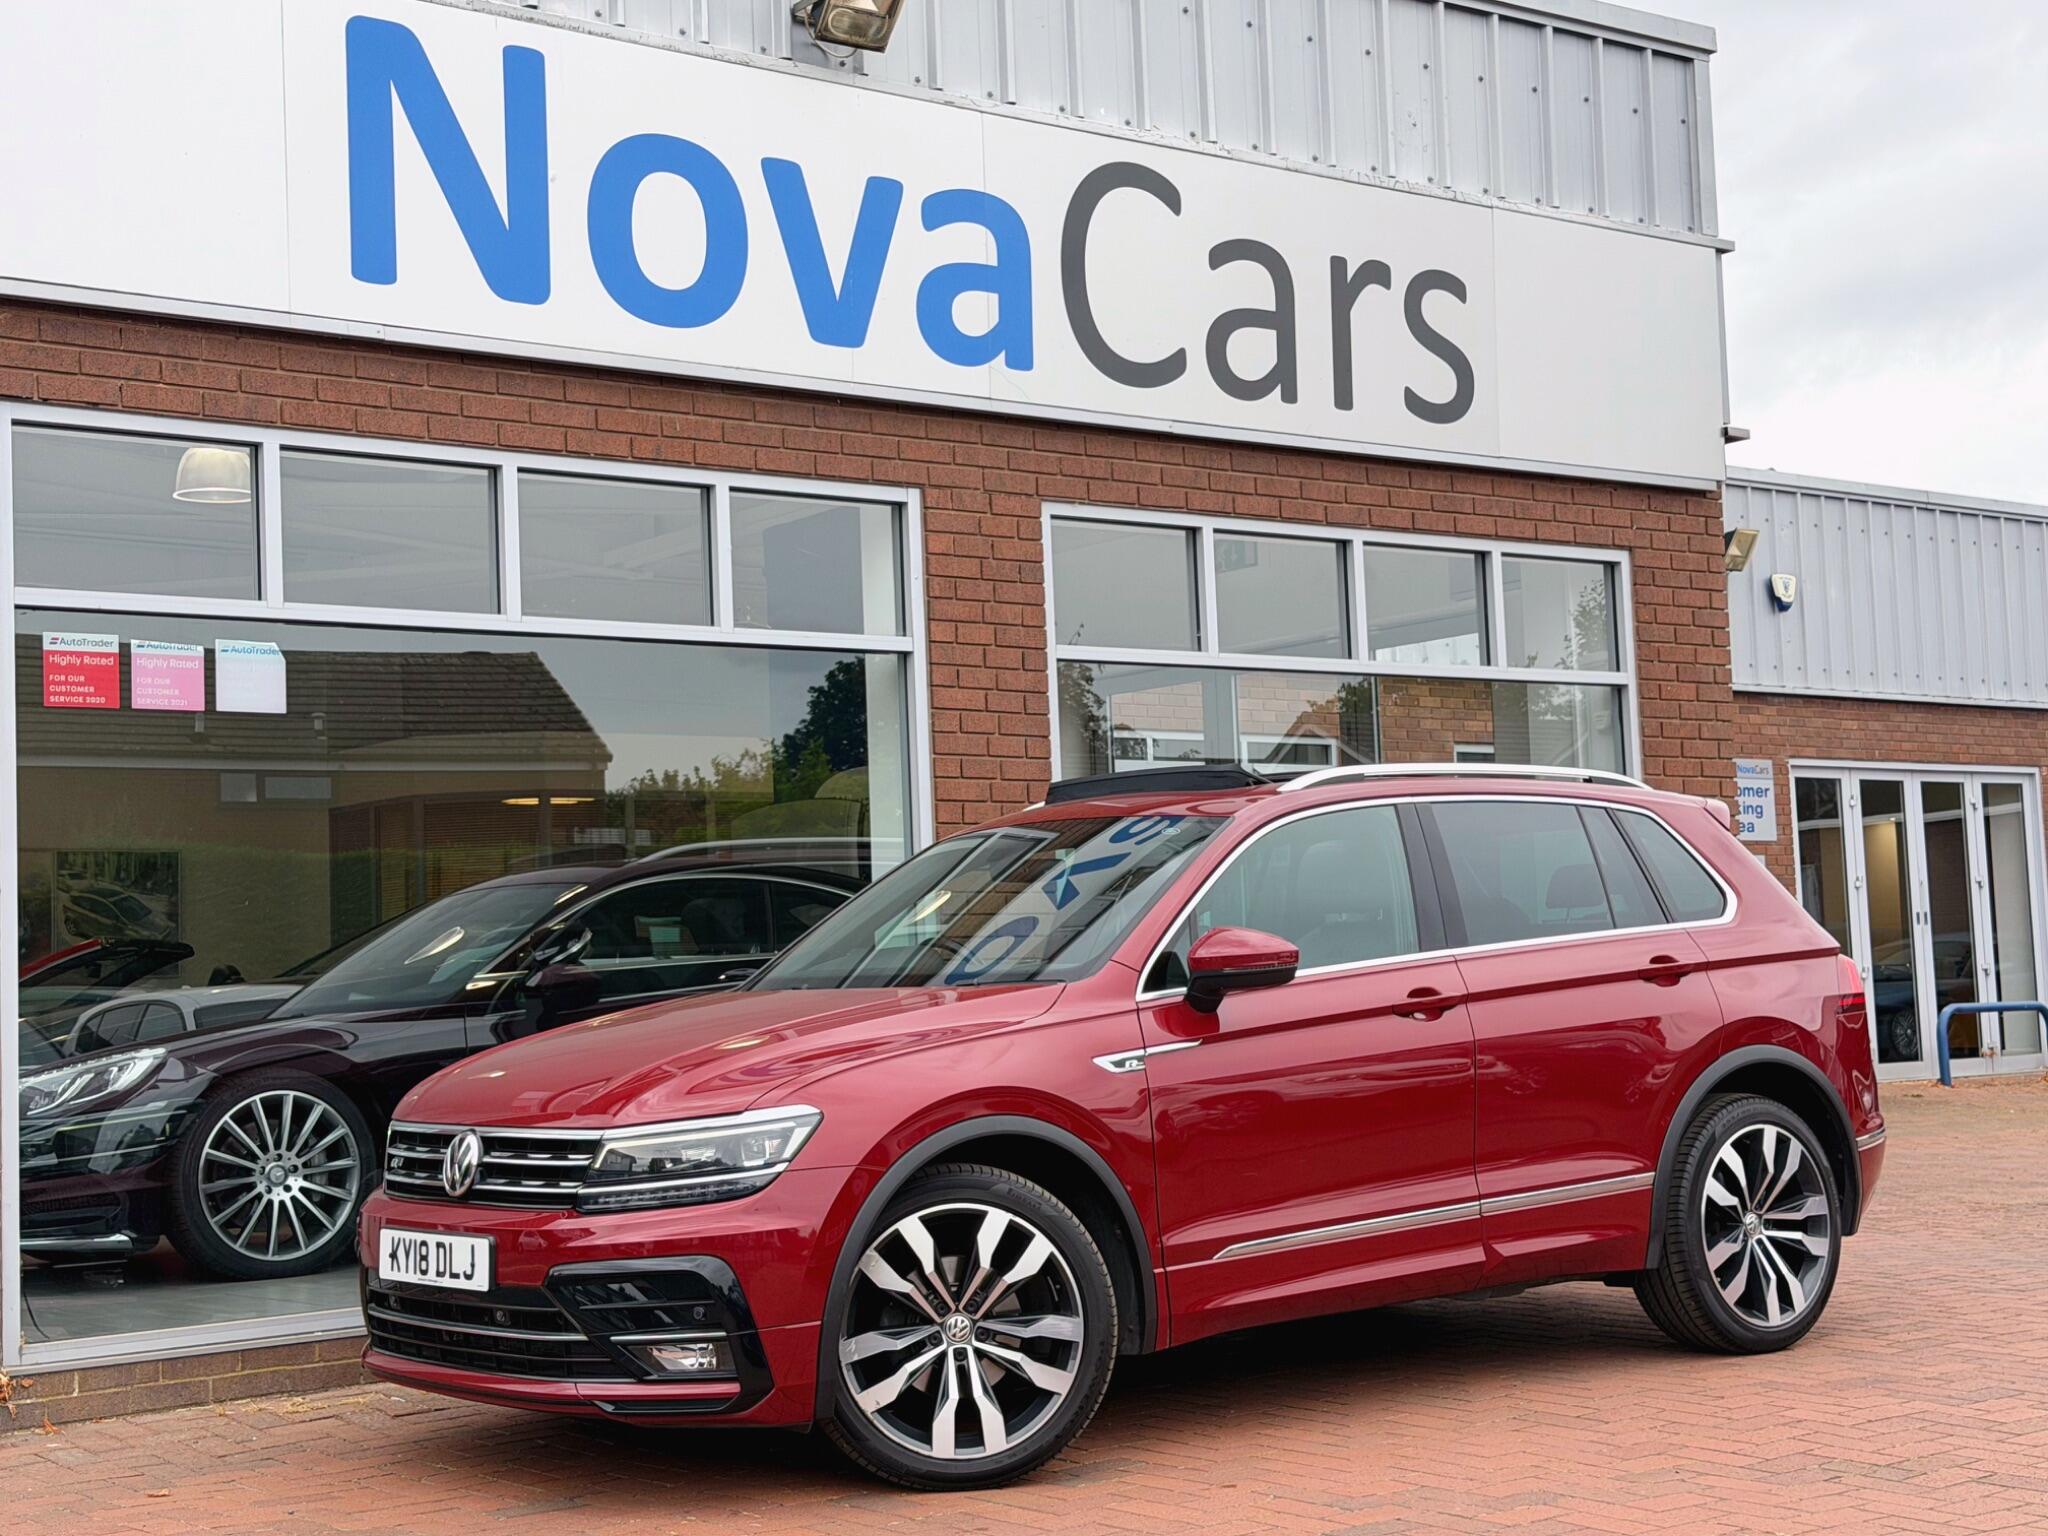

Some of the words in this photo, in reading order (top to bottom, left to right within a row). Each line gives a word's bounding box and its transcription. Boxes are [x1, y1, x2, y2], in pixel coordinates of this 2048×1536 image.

[346, 14, 1475, 425] NovaCars
[60, 637, 114, 647] AutoTrader
[49, 653, 81, 666] Highly
[83, 655, 114, 666] Rated
[136, 657, 168, 669] Highly
[169, 659, 199, 669] Rated
[49, 674, 66, 682] FOR
[49, 685, 95, 693] CUSTOMER
[49, 695, 84, 703] SERVICE
[85, 696, 106, 704] 2020
[1737, 764, 1770, 775] NovaCars
[389, 1236, 429, 1276] KY18
[435, 1241, 476, 1281] DLJ
